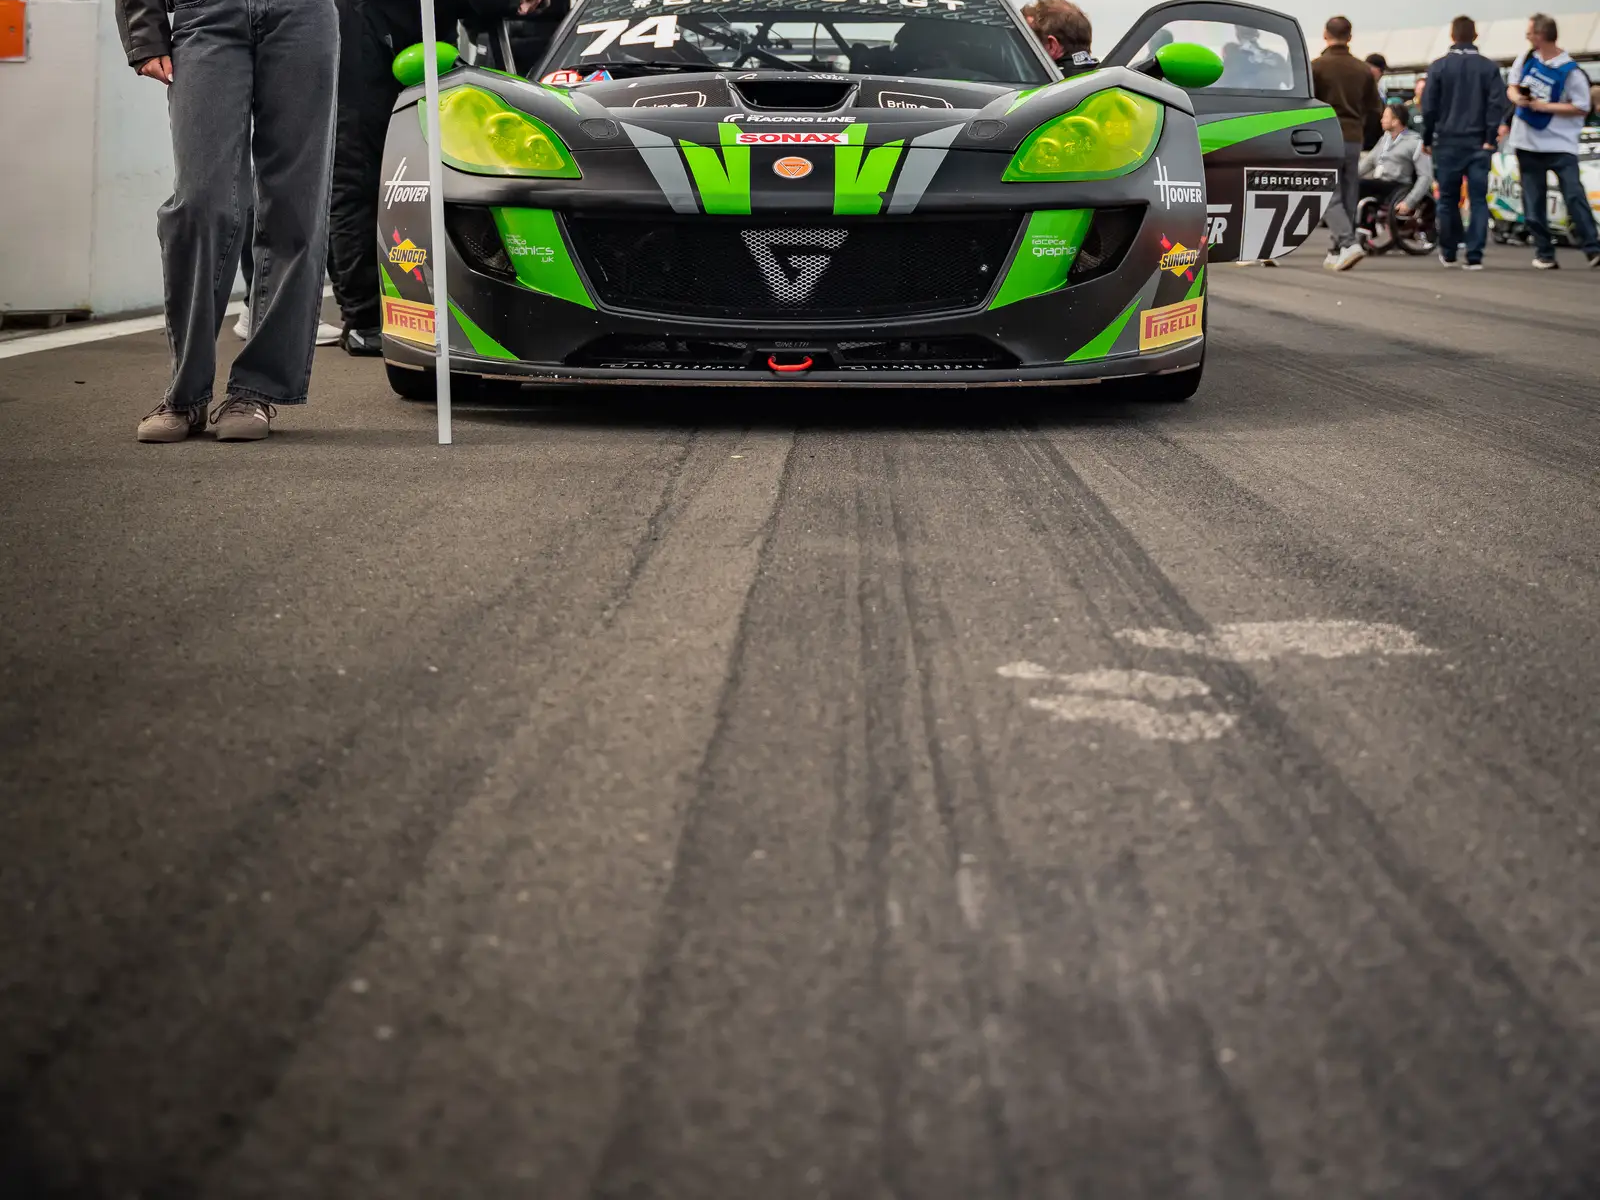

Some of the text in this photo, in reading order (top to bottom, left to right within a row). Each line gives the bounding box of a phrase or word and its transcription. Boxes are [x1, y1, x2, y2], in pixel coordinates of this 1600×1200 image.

[577, 14, 681, 57] 74
[746, 115, 814, 123] RACING
[739, 133, 842, 144] SONAX
[384, 157, 431, 210] HOOVER
[1153, 156, 1203, 210] HOOVER
[1254, 177, 1329, 186] #BRITISHGT
[389, 249, 426, 265] SUNOCO
[1161, 251, 1198, 268] SUNOCO
[1145, 303, 1198, 339] PIRELLI
